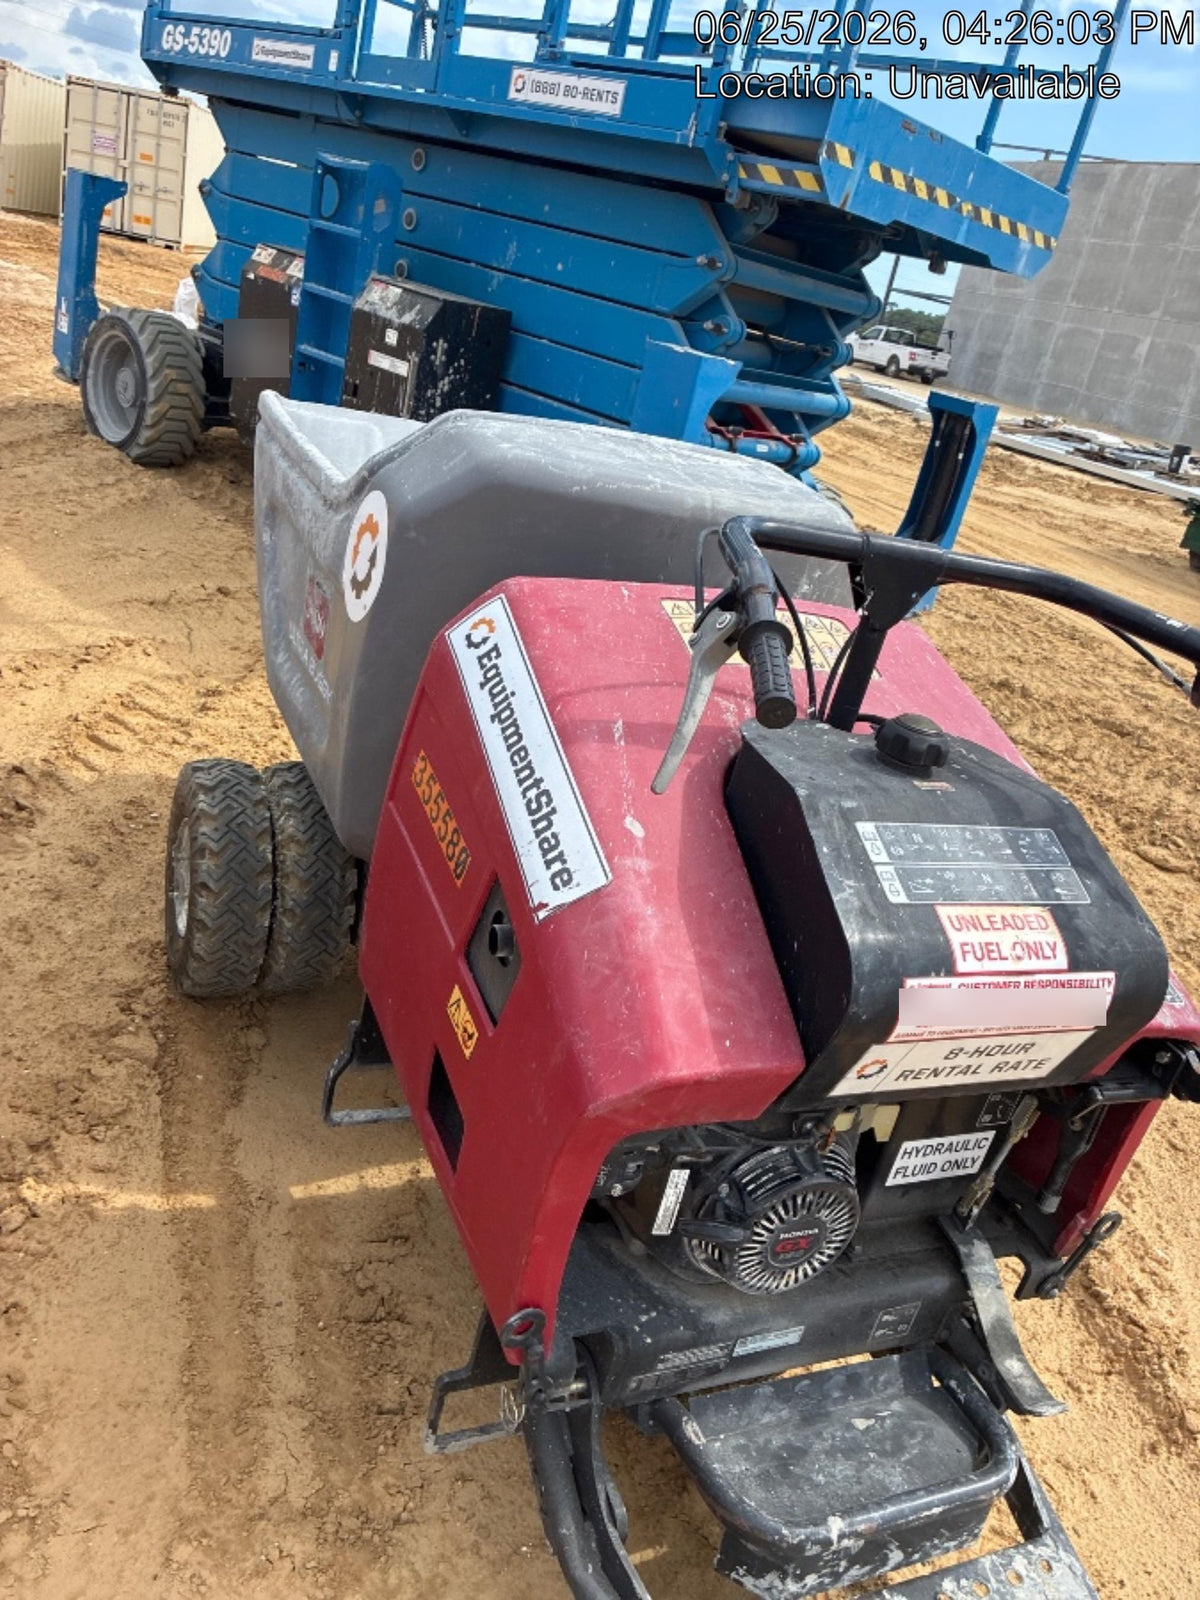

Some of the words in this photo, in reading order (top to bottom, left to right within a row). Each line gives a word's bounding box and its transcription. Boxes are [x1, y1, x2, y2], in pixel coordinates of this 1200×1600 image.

[161, 24, 232, 58] GS-5390
[476, 642, 574, 892] EquipmentShare
[413, 753, 470, 881] 355580
[947, 914, 1050, 933] UNLEADED
[960, 941, 1009, 963] FUEL
[1012, 940, 1058, 962] ONLY
[1023, 977, 1114, 989] RESPONSIBILITY
[943, 1042, 1037, 1061] 8-HOUR
[894, 1062, 981, 1083] RENTAL
[991, 1057, 1051, 1074] RATE
[900, 1137, 990, 1160] HYDRAULIC
[892, 1162, 938, 1180] FLUID
[941, 1155, 980, 1173] ONLY
